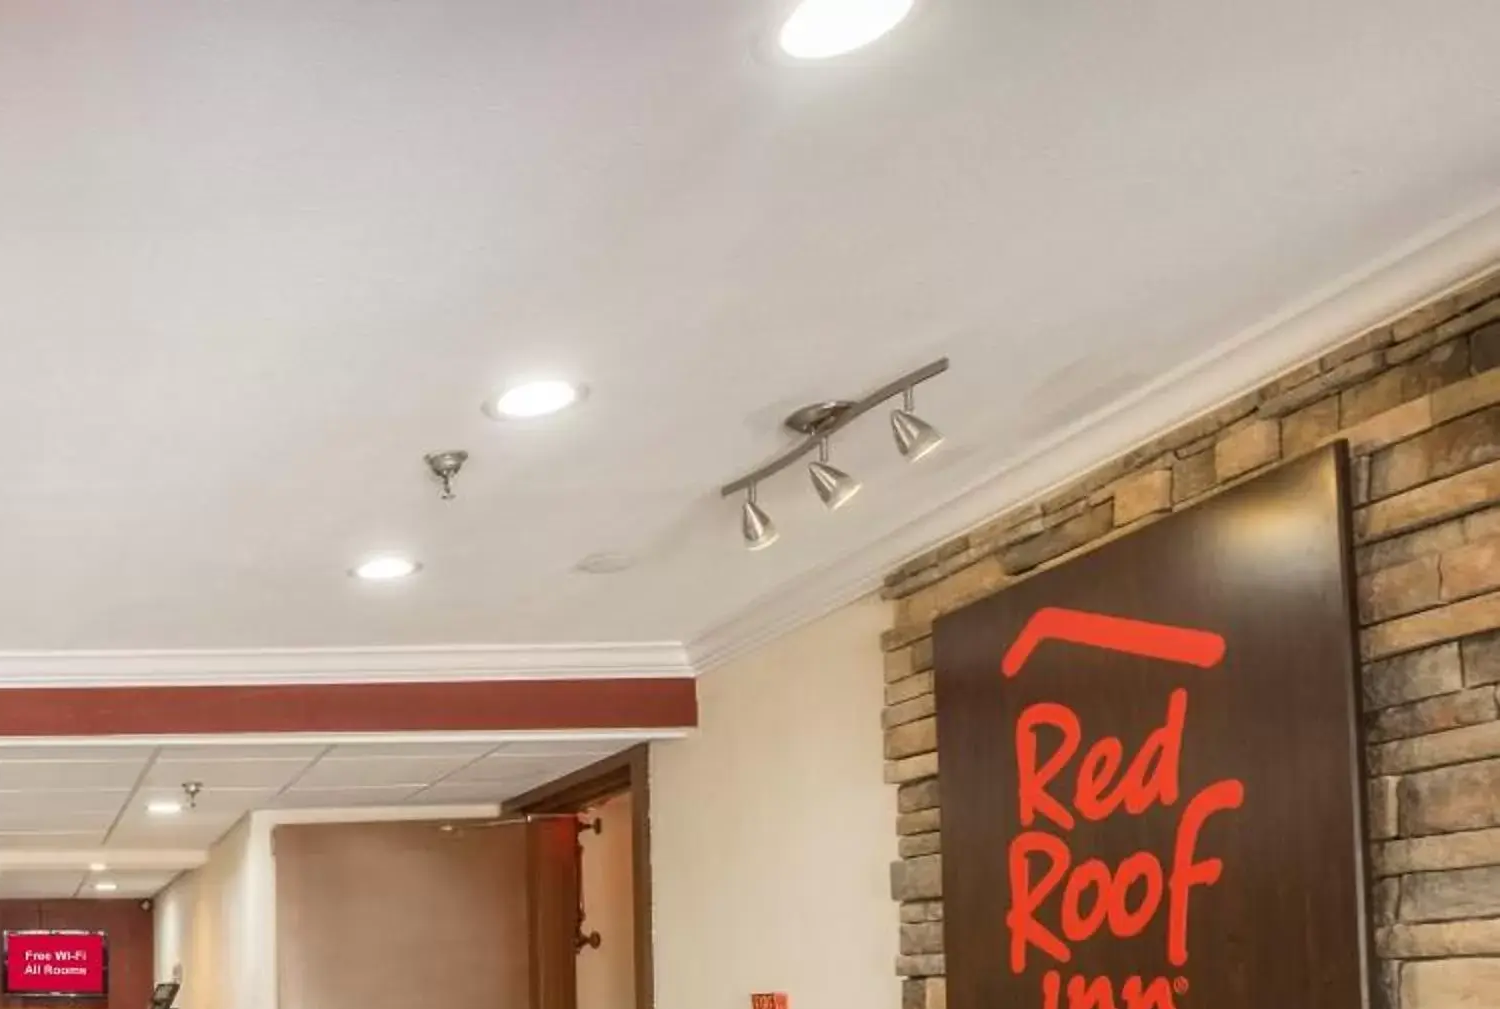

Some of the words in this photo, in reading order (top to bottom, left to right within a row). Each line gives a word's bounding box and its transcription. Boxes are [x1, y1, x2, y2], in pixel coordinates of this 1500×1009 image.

[1016, 688, 1187, 830] Red
[1006, 780, 1244, 973] Roof
[24, 964, 41, 975] All
[43, 964, 87, 975] Rooms
[25, 950, 52, 961] Free
[55, 950, 87, 961] Wi-Fi
